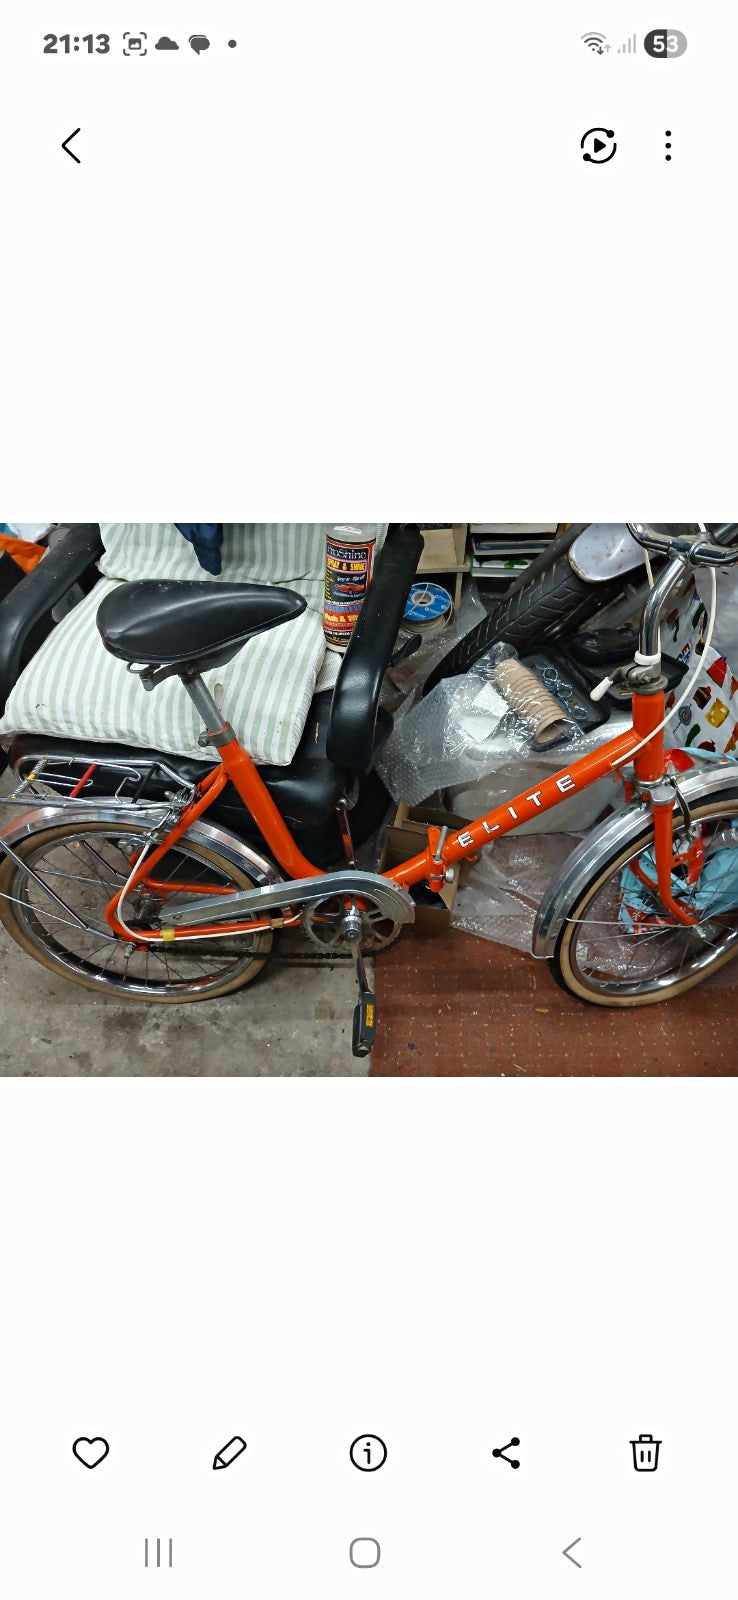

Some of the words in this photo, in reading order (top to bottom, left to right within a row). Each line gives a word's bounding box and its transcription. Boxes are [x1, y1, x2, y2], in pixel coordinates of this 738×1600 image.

[327, 545, 367, 559] ProShine
[342, 562, 347, 571] &
[350, 562, 365, 571] SHINE
[457, 774, 576, 848] ELITE
